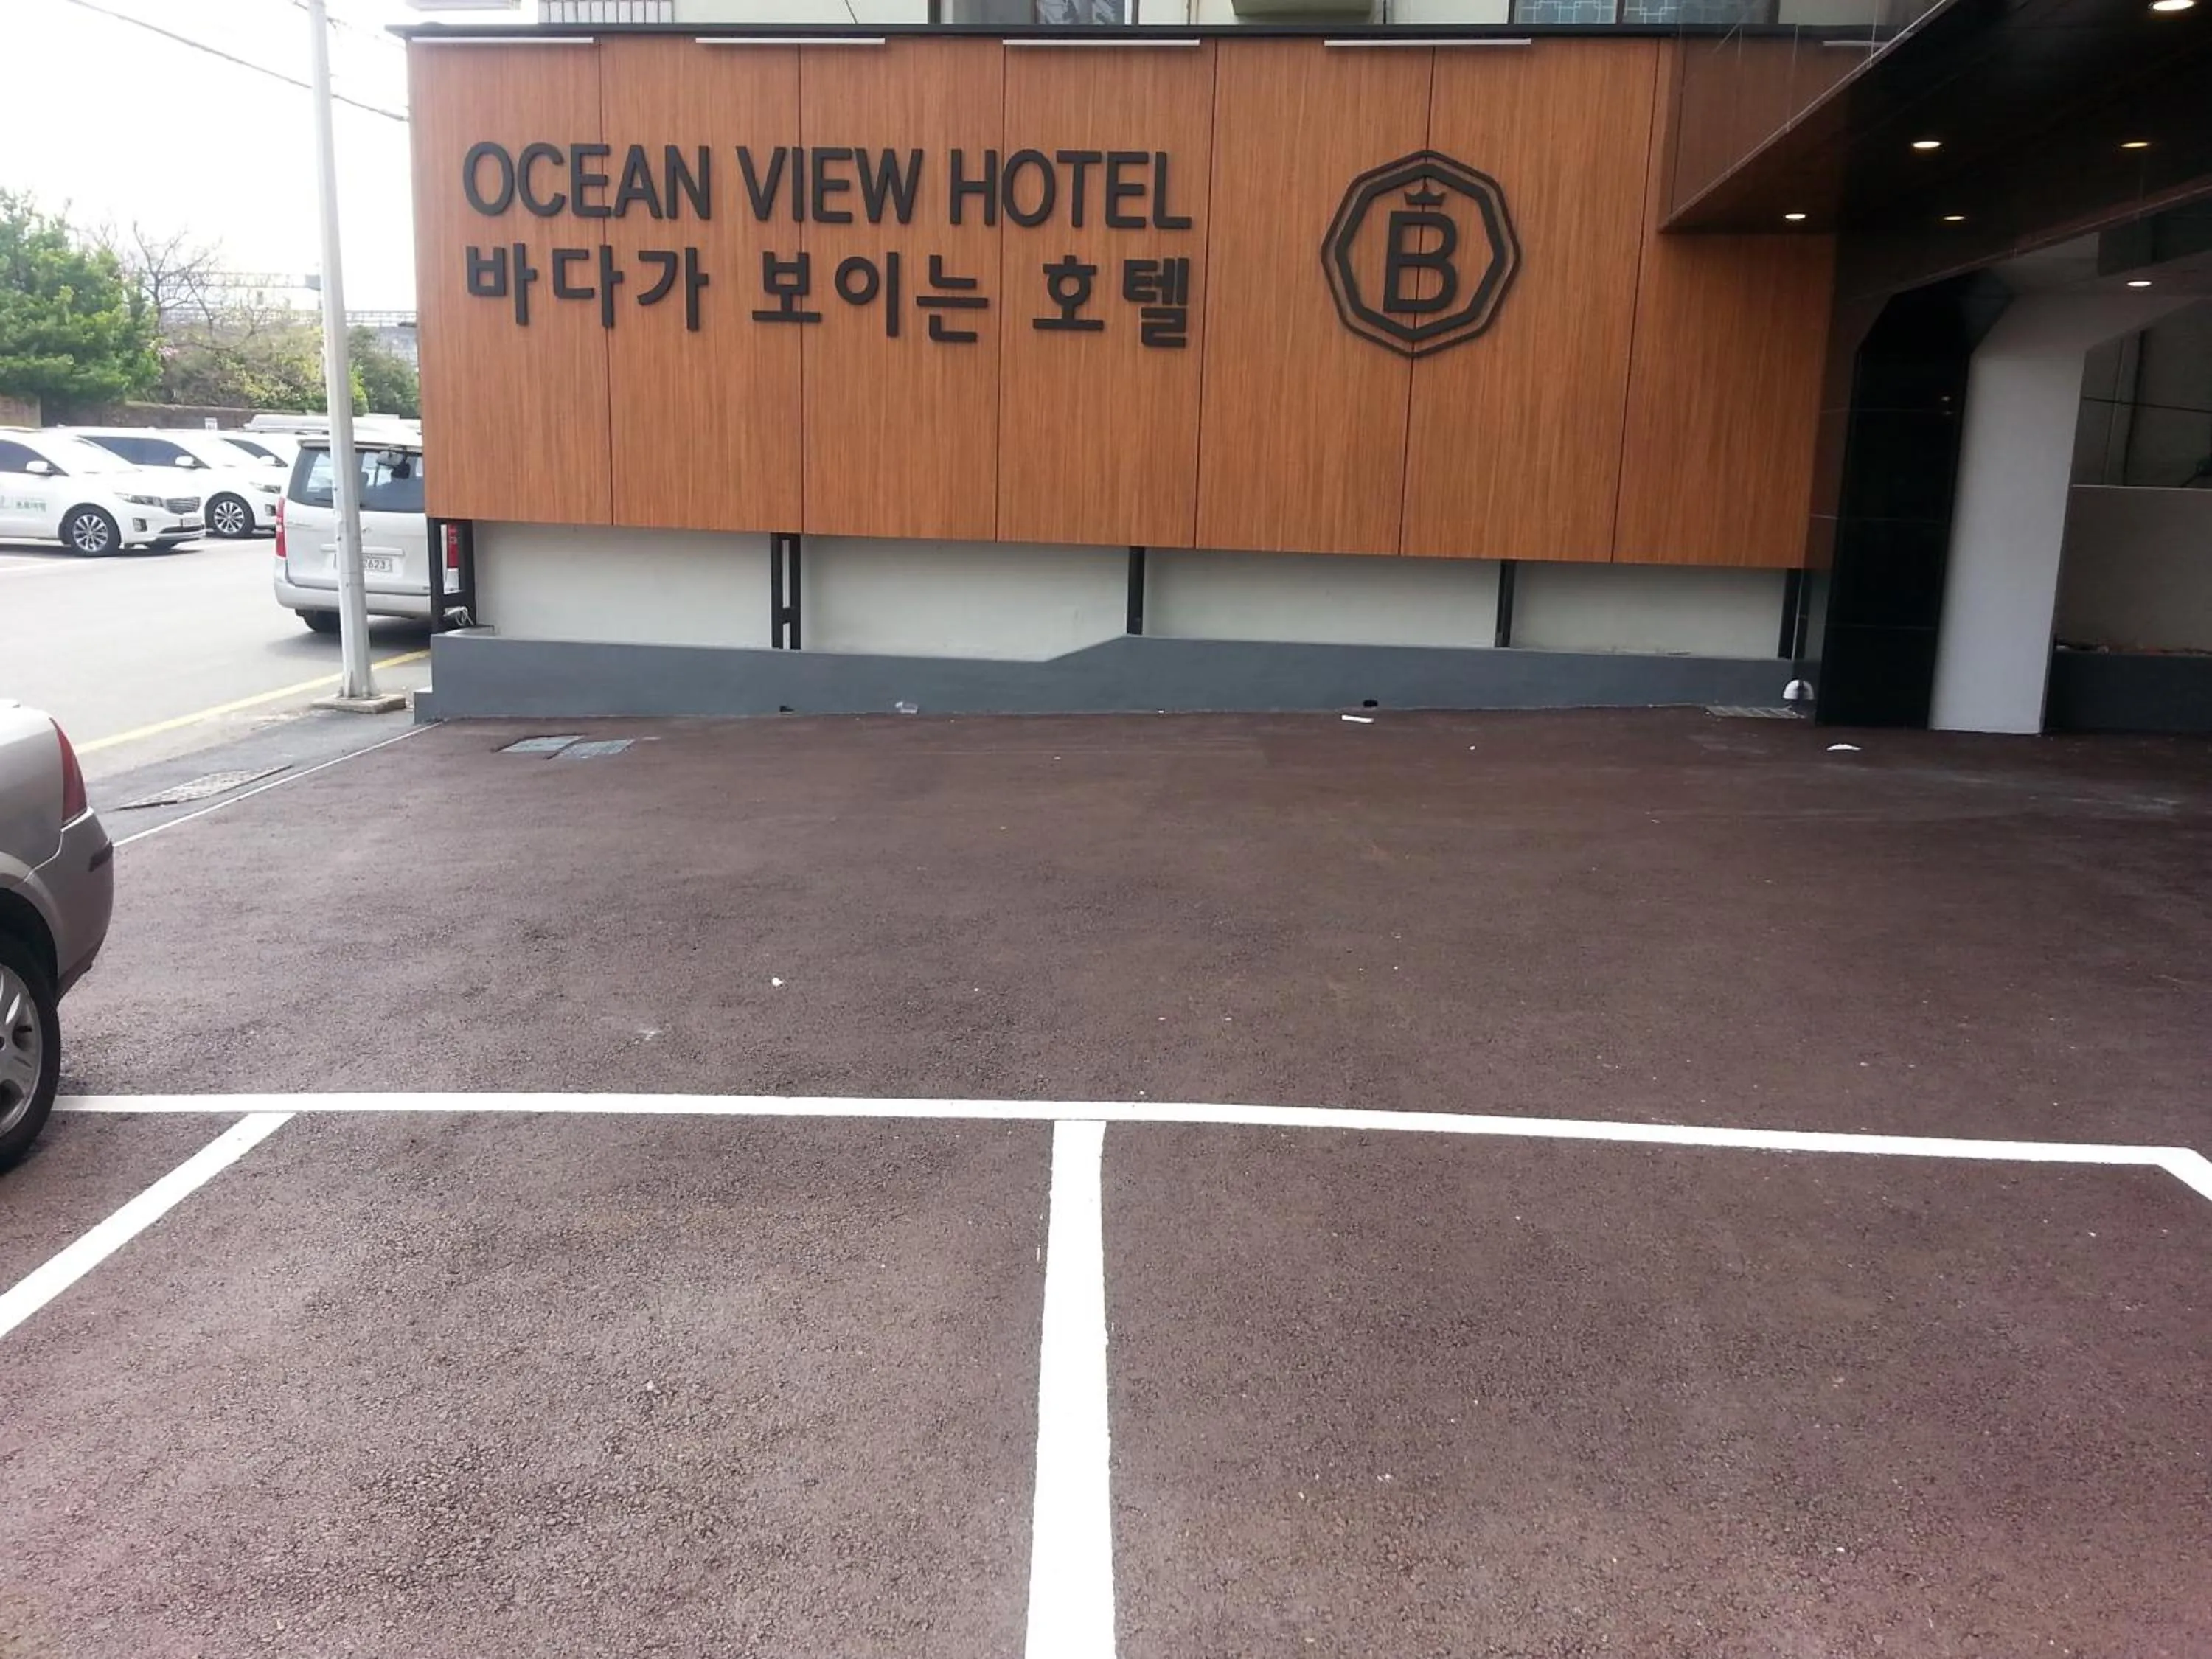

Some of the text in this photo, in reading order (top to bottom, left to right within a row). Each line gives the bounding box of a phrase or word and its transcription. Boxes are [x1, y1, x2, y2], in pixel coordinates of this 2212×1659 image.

[462, 141, 1193, 231] OCEAN VIEW HOTEL
[465, 243, 1191, 349] 바다가 보이는 호텔
[1382, 210, 1457, 313] B
